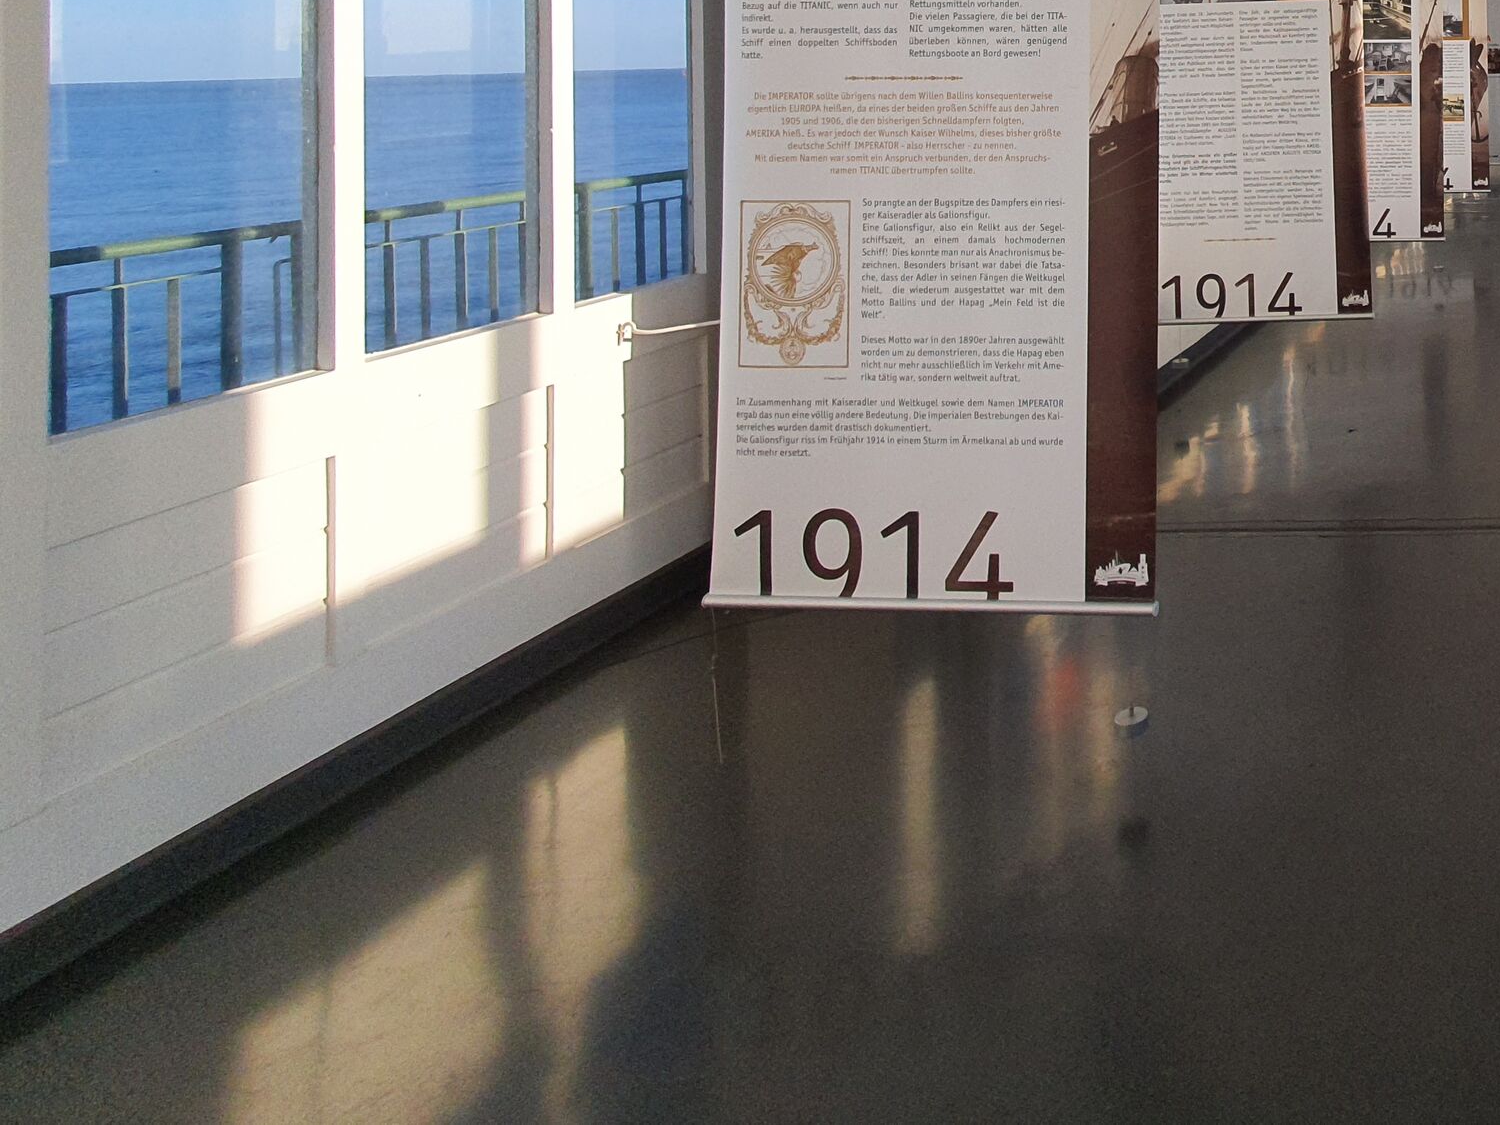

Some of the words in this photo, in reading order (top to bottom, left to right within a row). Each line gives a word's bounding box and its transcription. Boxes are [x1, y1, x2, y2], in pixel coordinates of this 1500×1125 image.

[909, 0, 975, 10] Rettungsmitteln
[976, 0, 1022, 8] vorhanden.
[908, 48, 969, 59] Rettungsboote
[982, 48, 1002, 57] Bord
[1003, 48, 1041, 60] gewesen!
[859, 165, 889, 175] TITANIC
[890, 165, 948, 175] übertrumpfen
[949, 165, 976, 175] sollte.
[861, 212, 875, 221] ger
[877, 210, 922, 219] Kaiseradler
[924, 210, 936, 219] als
[937, 210, 991, 221] Galionsfigur.
[1161, 271, 1303, 320] 1914
[860, 372, 876, 381] rika
[877, 373, 897, 383] tätig
[898, 374, 915, 382] war,
[917, 373, 951, 382] sondern
[953, 373, 987, 382] weltweit
[989, 373, 1020, 383] auftrat.
[735, 447, 755, 456] nicht
[756, 448, 777, 457] mehr
[779, 448, 811, 457] ersetzt.
[732, 507, 1015, 600] 1914
